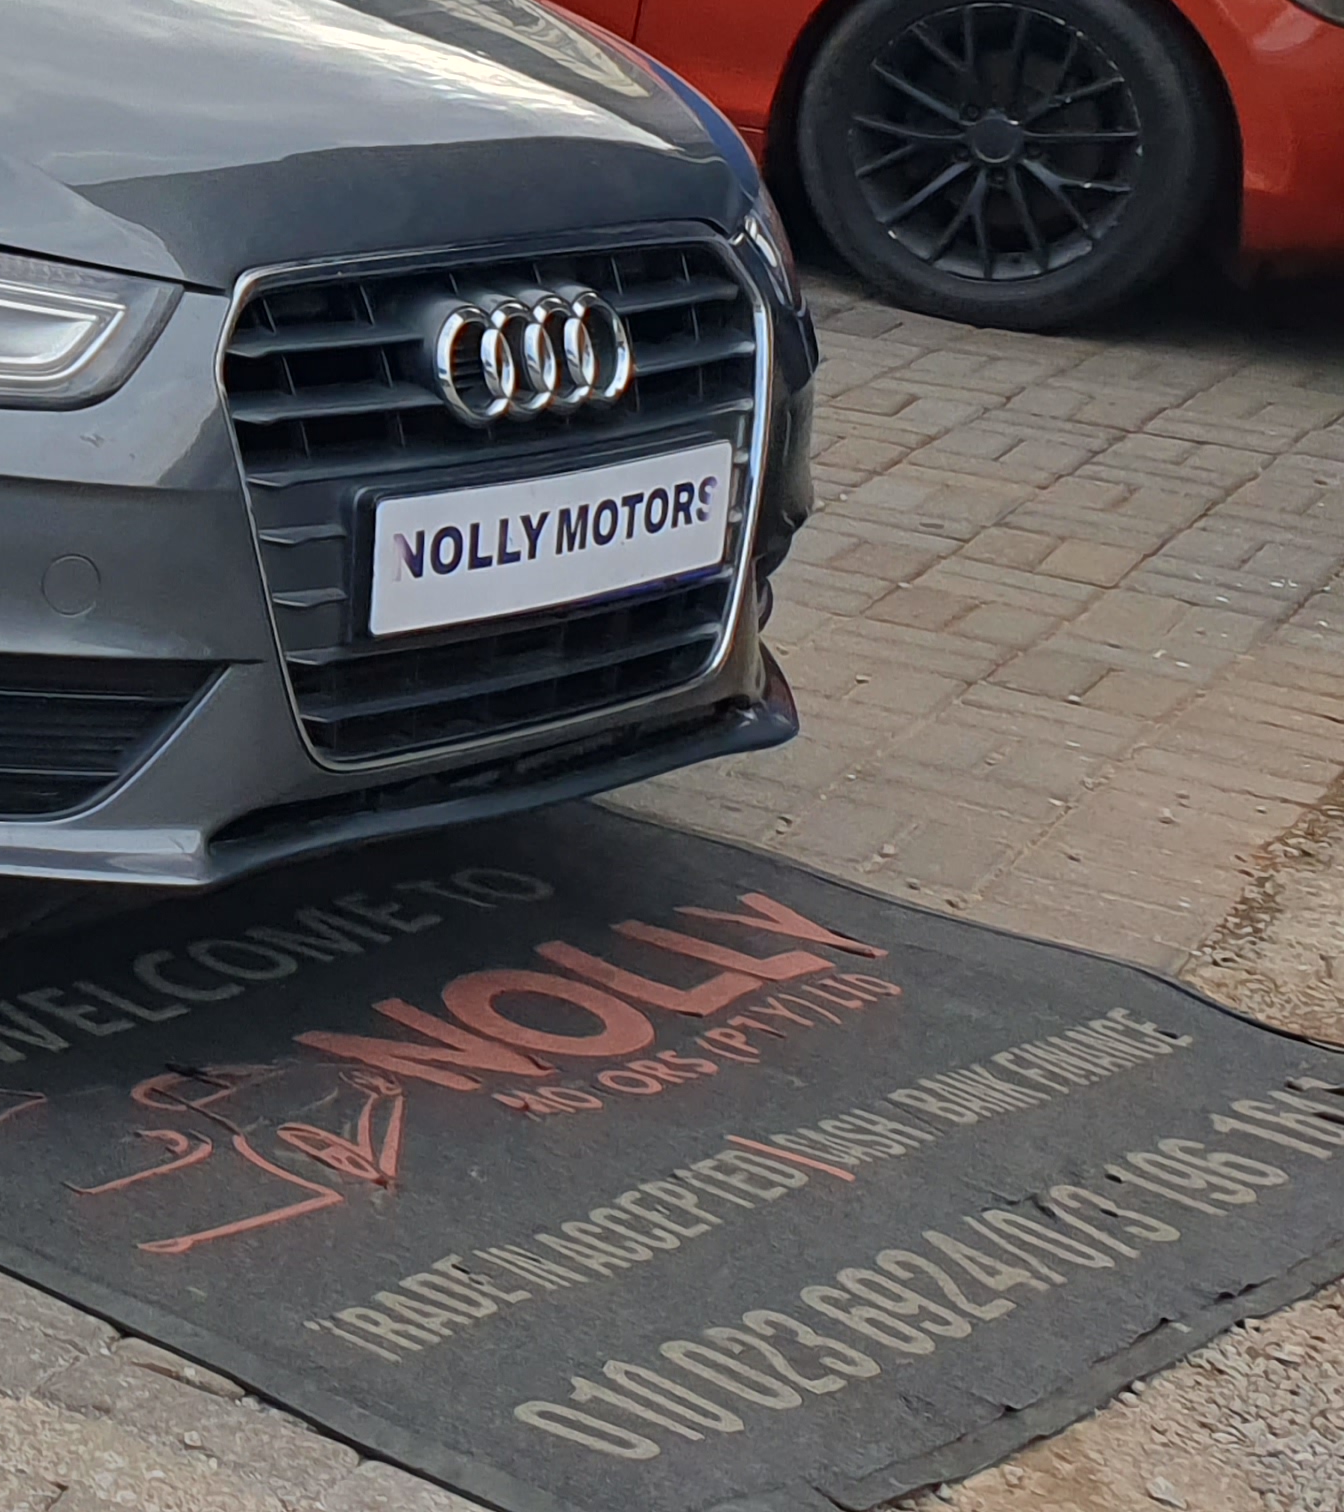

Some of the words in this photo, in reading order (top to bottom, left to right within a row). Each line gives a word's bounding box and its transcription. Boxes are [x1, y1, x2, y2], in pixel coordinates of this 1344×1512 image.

[393, 509, 551, 582] NOLLY
[555, 475, 718, 556] MOTORS
[393, 867, 555, 908] TO
[292, 892, 888, 1090] NOLLY
[492, 1049, 720, 1121] MOORS
[471, 1243, 590, 1290] IN
[534, 1149, 810, 1277] ACCEPTED
[888, 1063, 1053, 1125] BANK
[513, 1359, 745, 1460] 010
[658, 1309, 883, 1410] 023
[1103, 1137, 1291, 1218] 196
